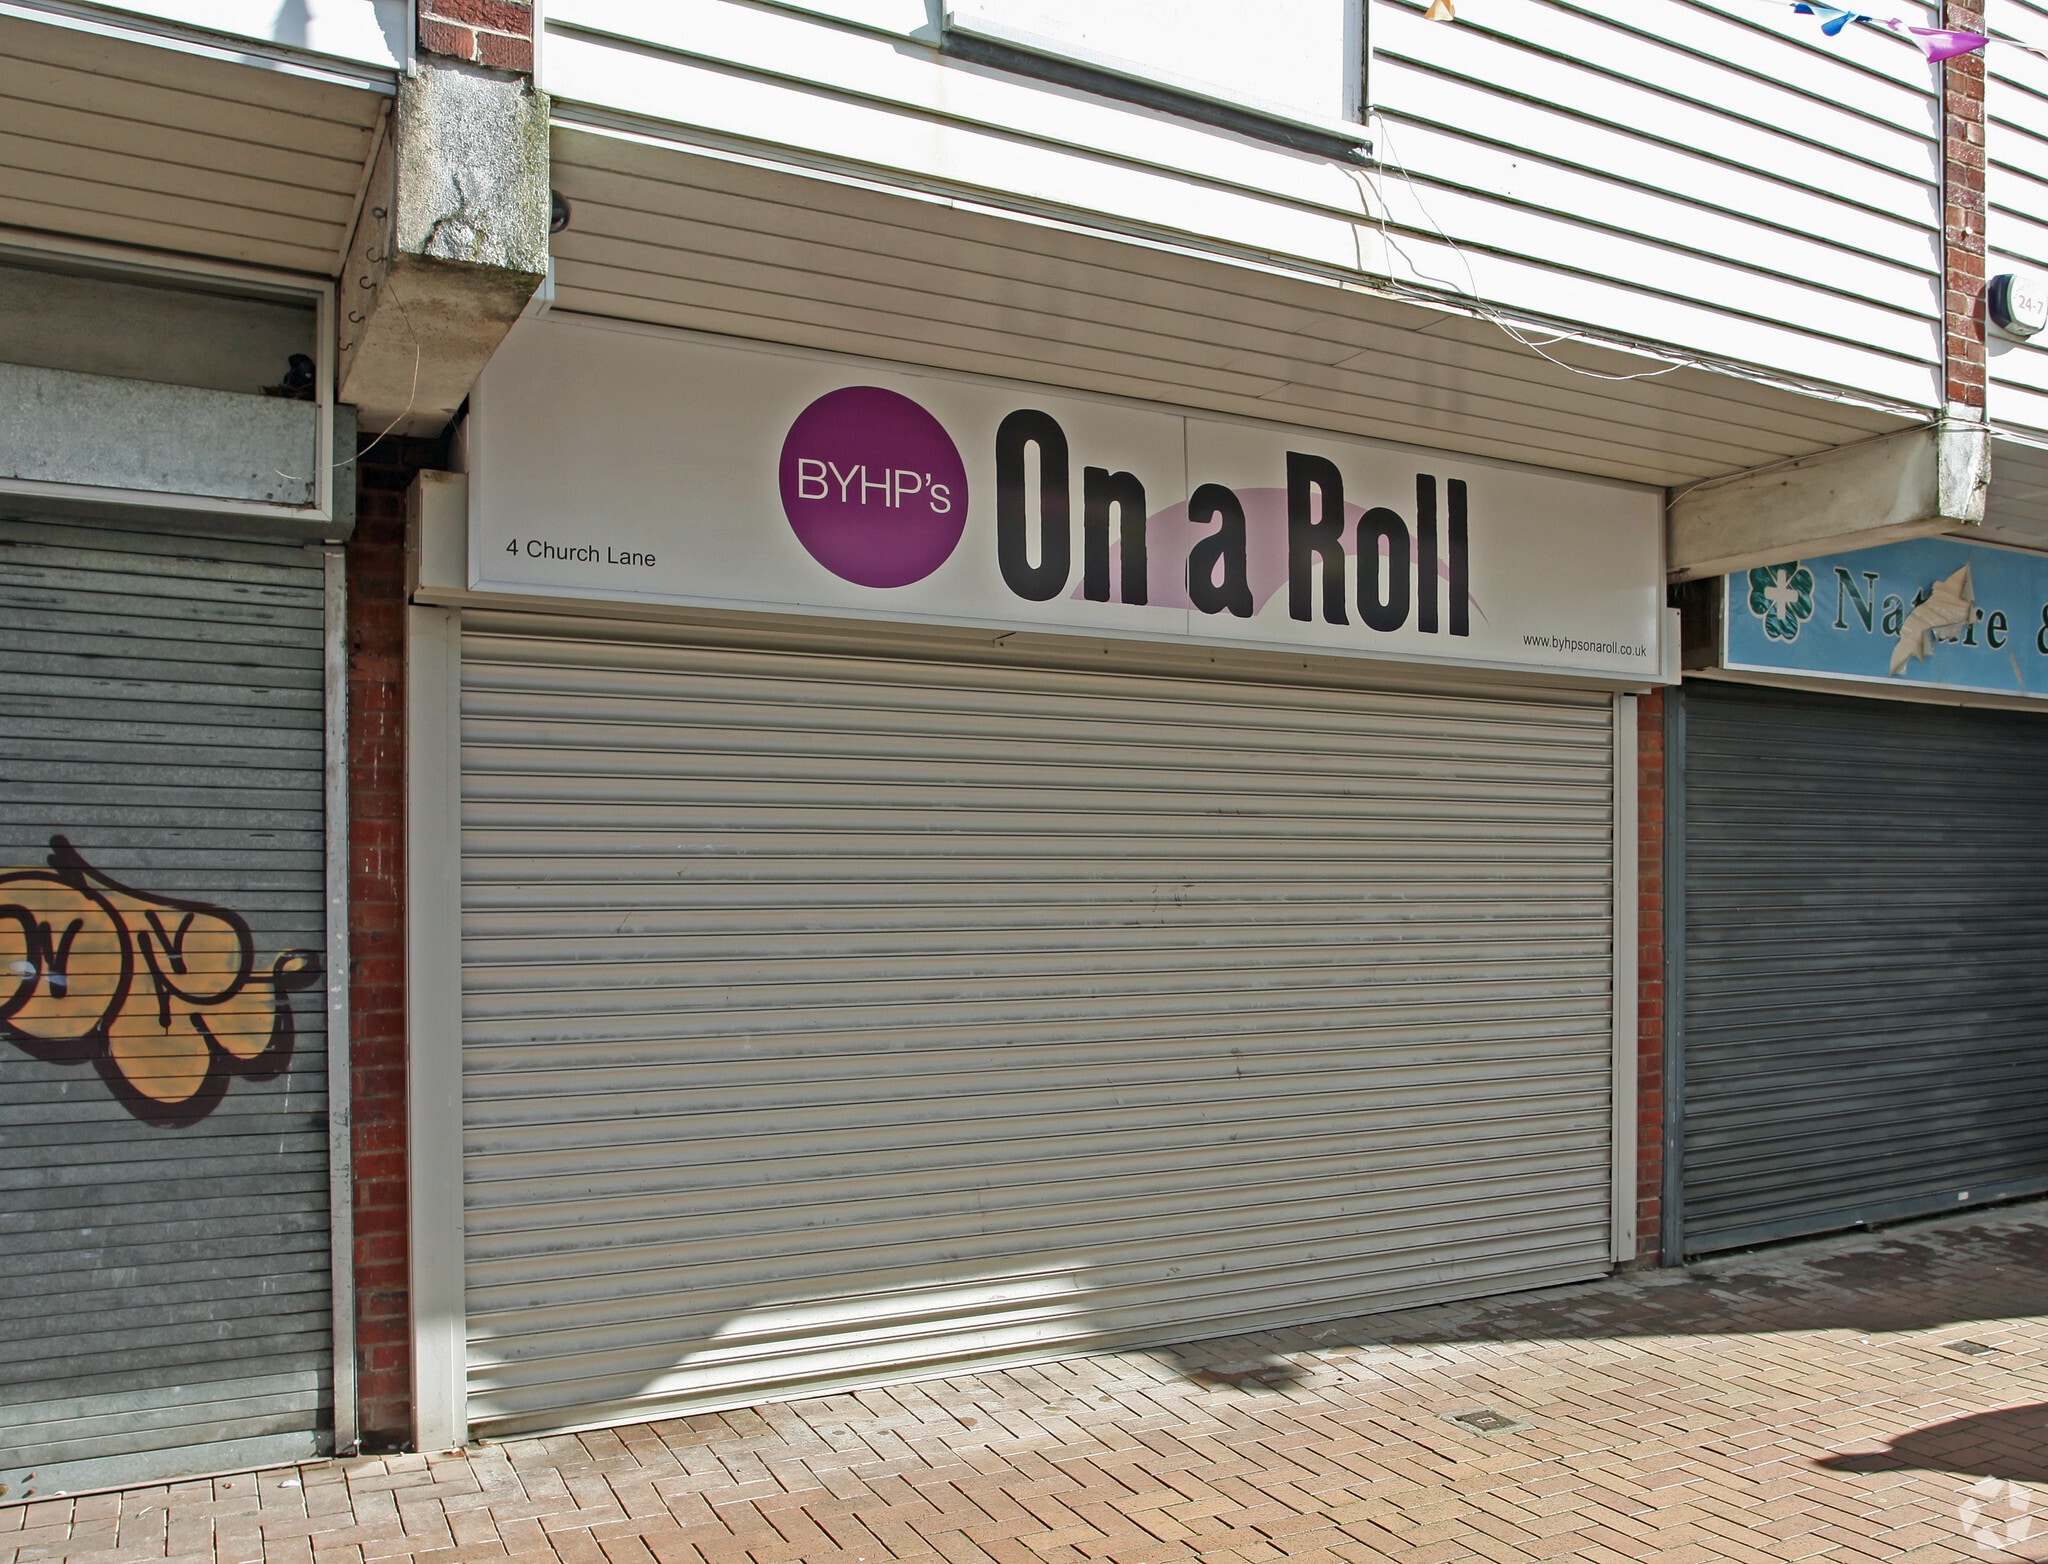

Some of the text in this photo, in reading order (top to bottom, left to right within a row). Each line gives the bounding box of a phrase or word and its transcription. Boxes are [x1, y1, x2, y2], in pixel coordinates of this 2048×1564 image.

[2018, 294, 2044, 315] 24-7
[798, 457, 953, 514] BYHP's
[996, 409, 1470, 637] On a Roll
[506, 538, 656, 567] 4 Church Lane
[1832, 567, 2009, 650] Nare
[1523, 635, 1647, 657] www.byhpsonaroll.co.uk
